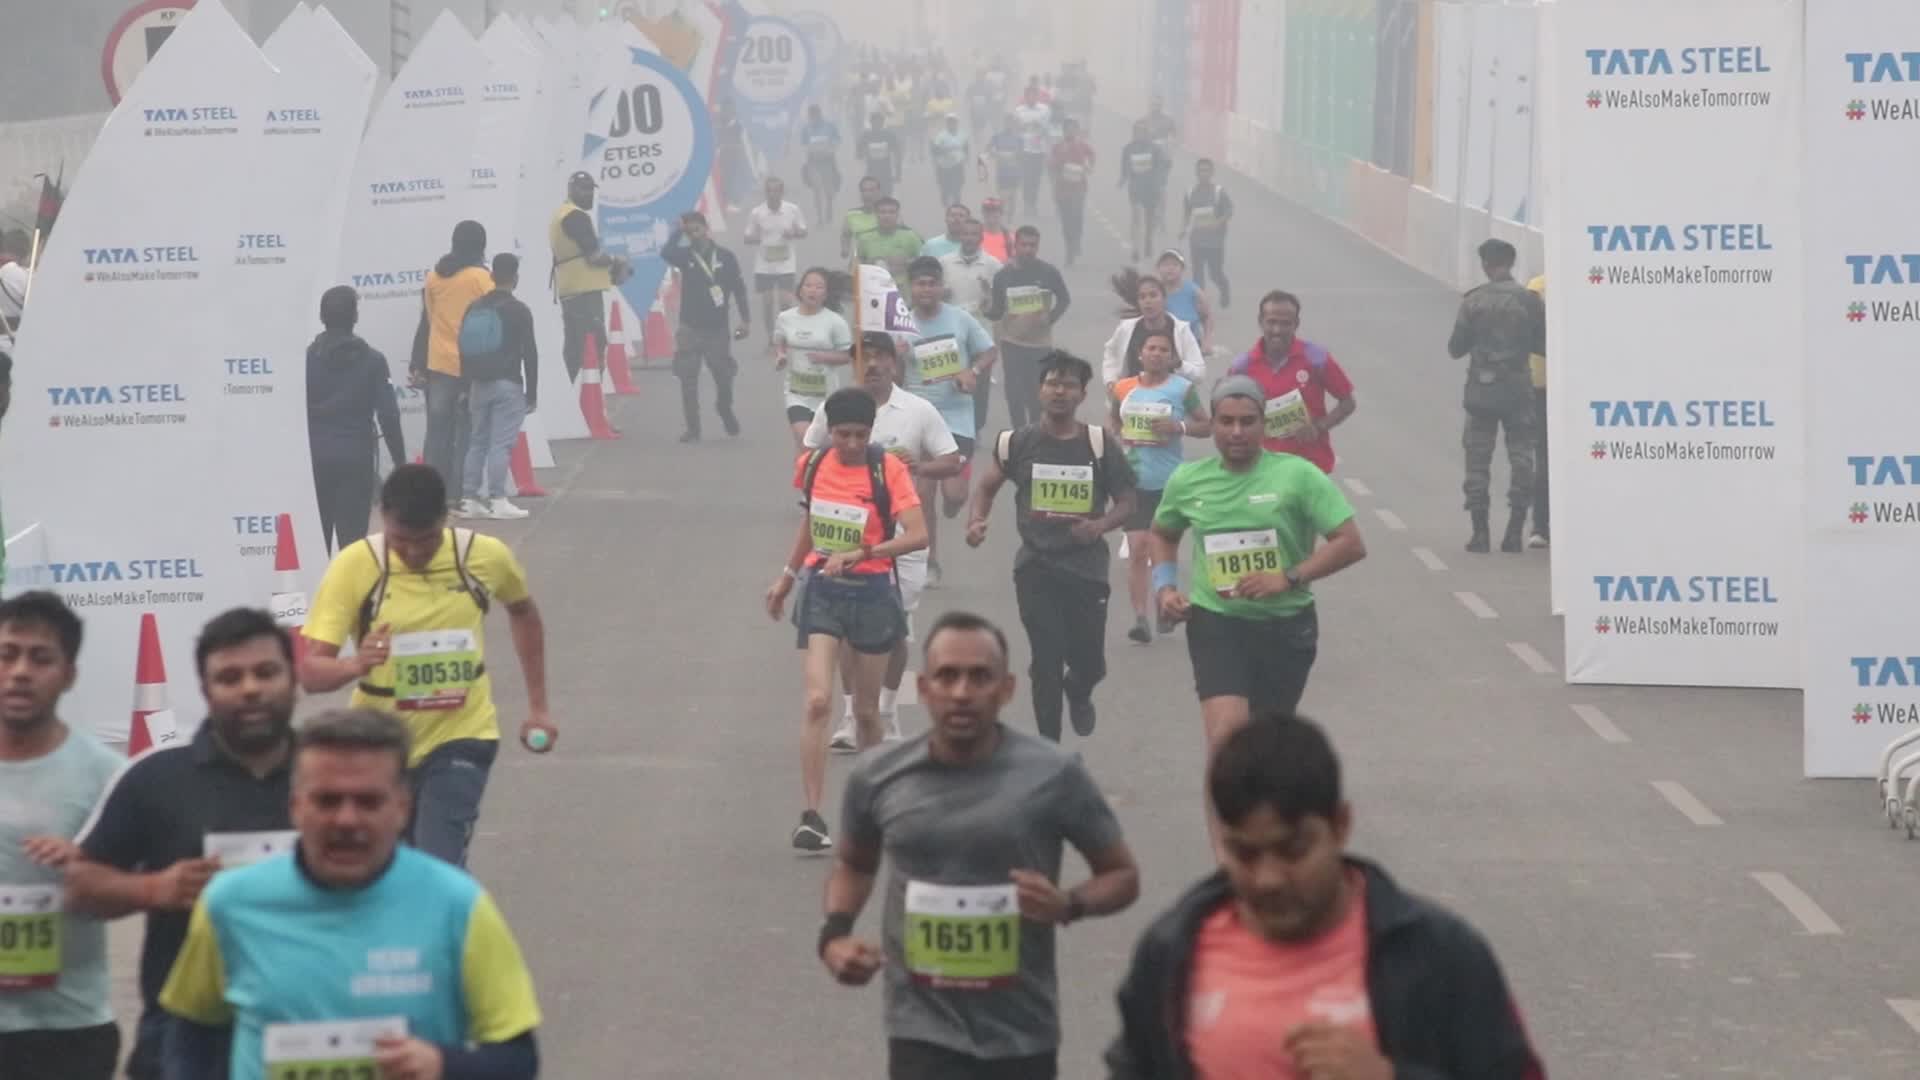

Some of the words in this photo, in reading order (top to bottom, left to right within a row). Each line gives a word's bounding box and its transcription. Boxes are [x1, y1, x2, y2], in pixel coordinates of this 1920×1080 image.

[740, 35, 793, 64] 200
[1585, 48, 1673, 75] TATA
[1681, 46, 1771, 73] STEEL
[404, 90, 432, 100] TATA
[434, 86, 464, 97] STEEL
[1586, 88, 1771, 109] #WeAlsoMakeTomorrow
[143, 108, 188, 122] TATA
[192, 106, 238, 121] STEEL
[280, 108, 321, 121] STEEL
[628, 162, 656, 178] GO
[370, 181, 407, 195] TATA
[408, 179, 445, 191] STEEL
[1587, 225, 1675, 251] TATA
[1683, 224, 1772, 250] STEEL
[83, 248, 139, 265] TATA
[143, 246, 199, 263] STEEL
[351, 272, 394, 288] TATA
[1588, 266, 1773, 285] #WeAlsoMakeTomorrow
[48, 386, 114, 406] TATA
[119, 383, 186, 403] STEEL
[49, 412, 187, 428] #WeAlsoMakeTomorrow
[1590, 400, 1678, 427] TATA
[1685, 400, 1775, 427] STEEL
[1591, 440, 1775, 460] #WeAlsoMakeTomorrow
[1040, 481, 1090, 501] 17145
[812, 520, 861, 543] 200160
[49, 561, 123, 583] TATA
[128, 558, 203, 581] STEEL
[1216, 550, 1278, 574] 18158
[1593, 575, 1681, 603] TATA
[1688, 576, 1778, 603] STEEL
[1595, 614, 1779, 637] #WeAlsoMakeTomorrow
[407, 659, 475, 686] 30538
[920, 918, 1011, 952] 16511
